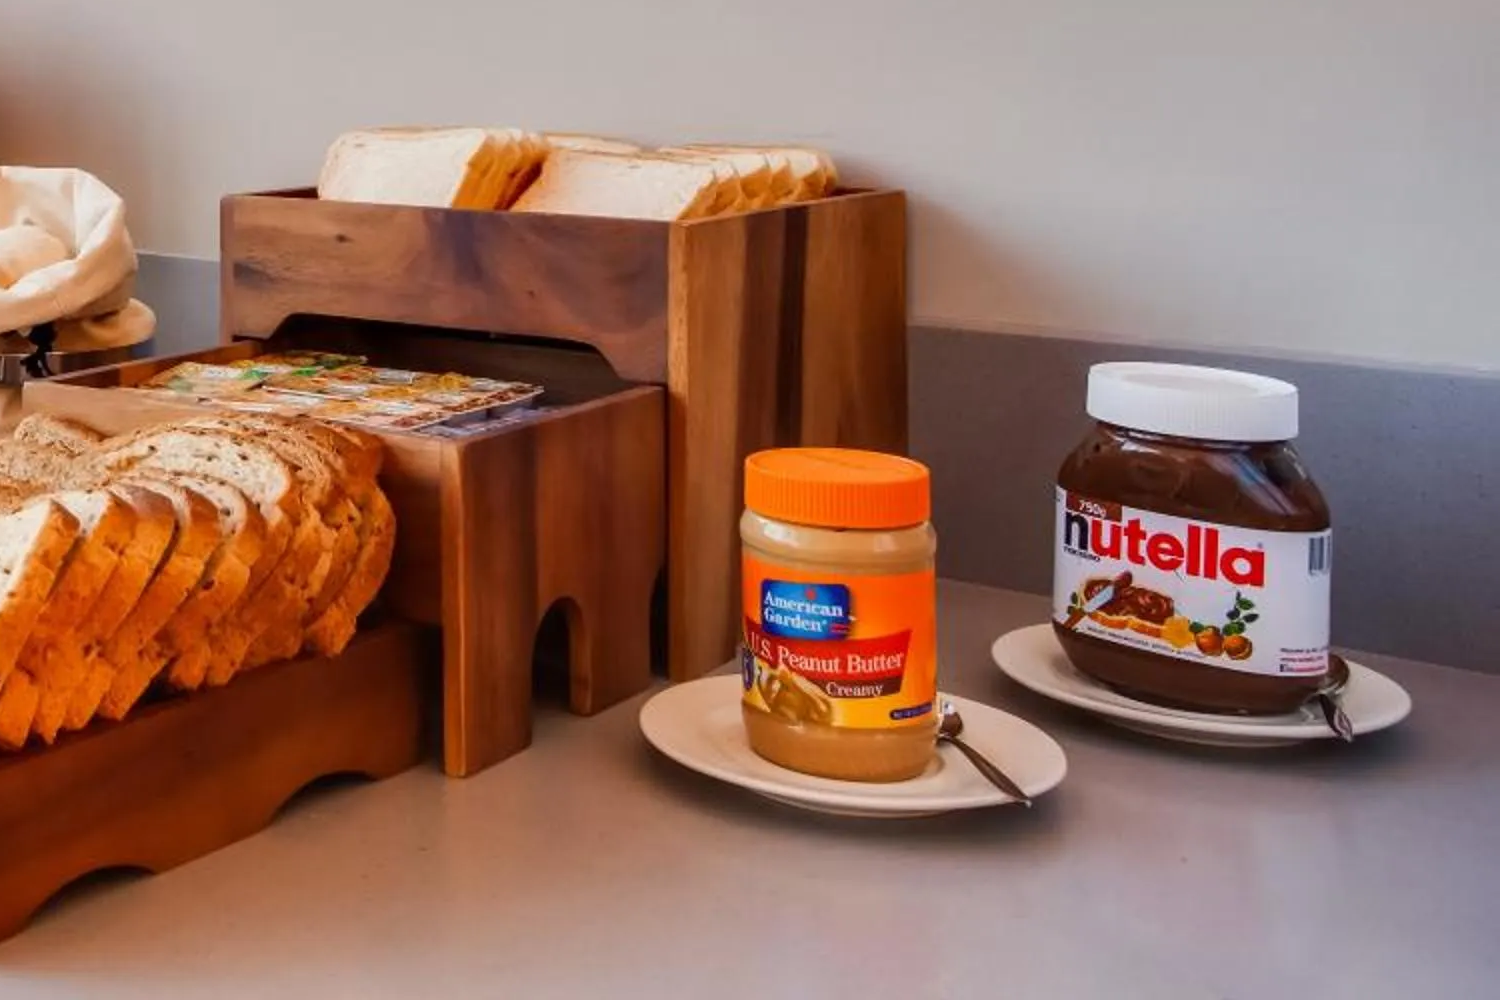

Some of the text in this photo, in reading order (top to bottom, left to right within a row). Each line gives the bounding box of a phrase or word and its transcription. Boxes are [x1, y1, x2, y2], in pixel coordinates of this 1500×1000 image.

[1063, 511, 1265, 588] nutella
[764, 591, 844, 617] American
[764, 607, 822, 632] Garden
[778, 645, 840, 674] Peanut
[847, 651, 905, 674] Butter
[825, 681, 884, 697] Creamy
